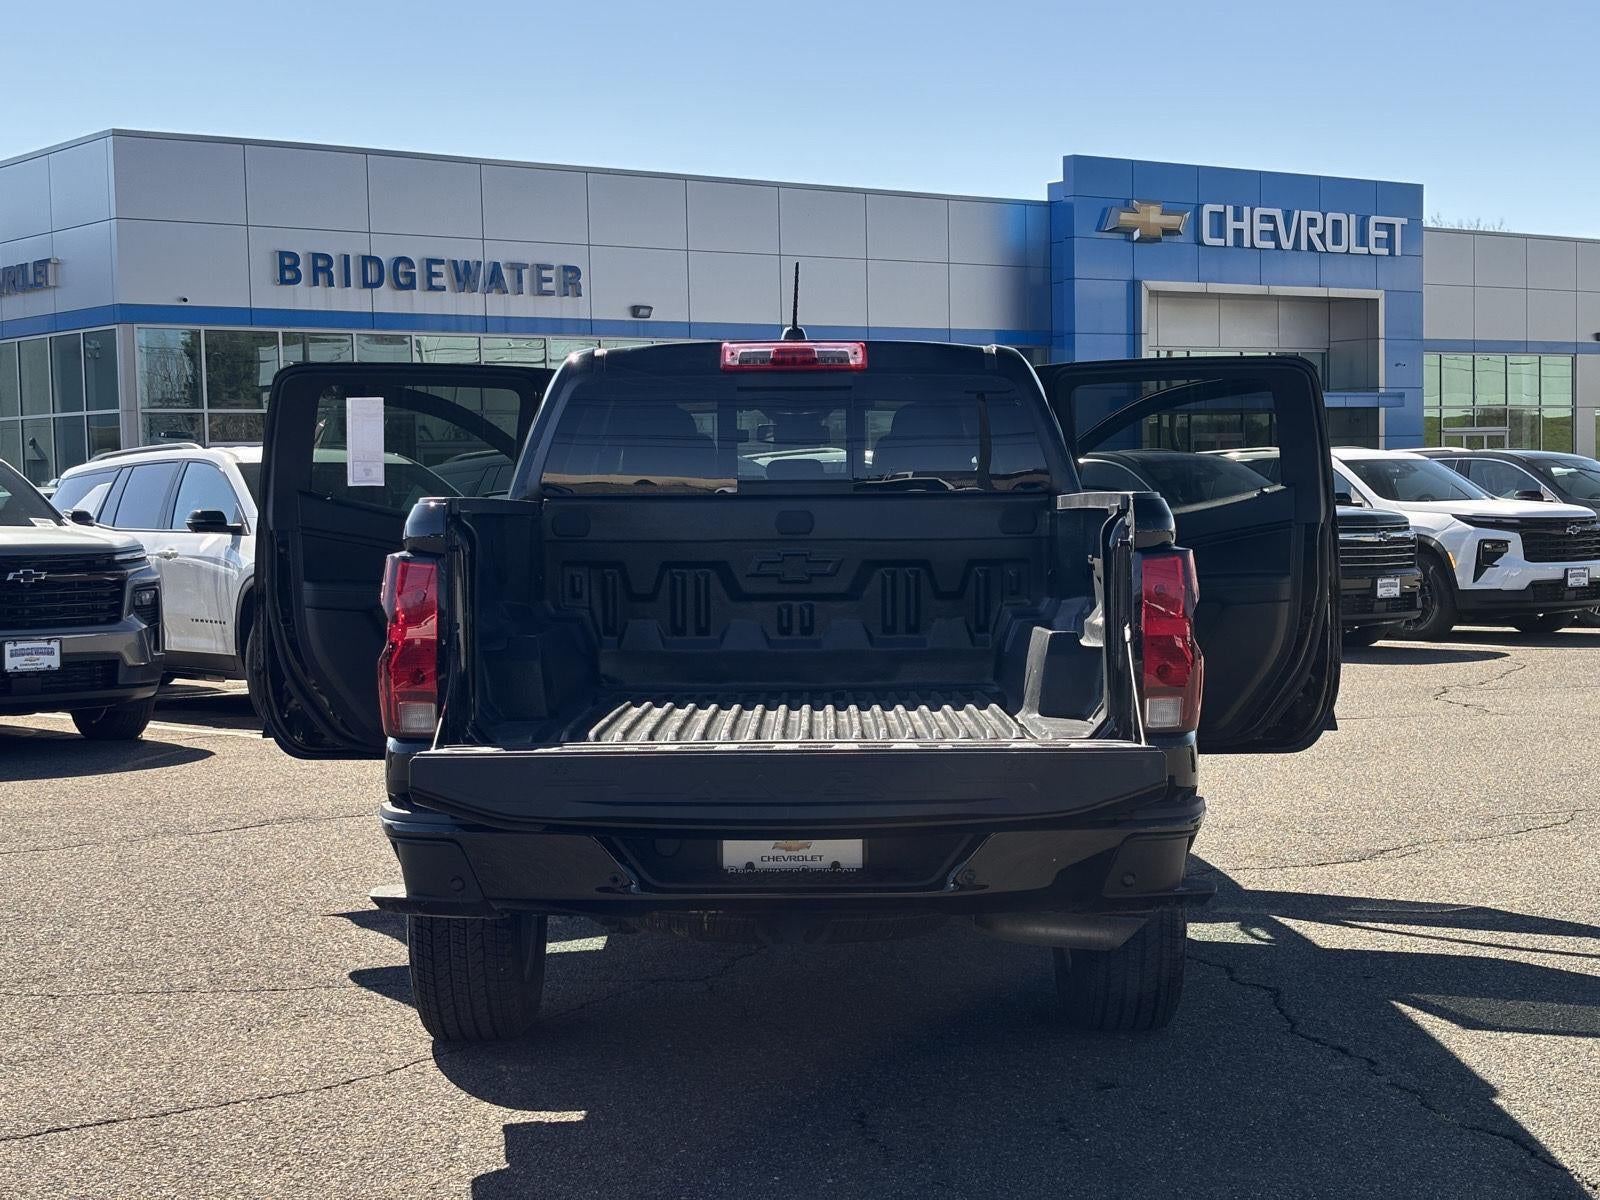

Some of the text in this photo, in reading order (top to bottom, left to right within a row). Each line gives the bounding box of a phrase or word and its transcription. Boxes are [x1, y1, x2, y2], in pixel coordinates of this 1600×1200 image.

[1202, 203, 1408, 257] CHEVROLET
[0, 258, 59, 294] ROLET
[276, 250, 583, 297] BRIDGEWATER
[760, 854, 825, 863] CHEVROLET
